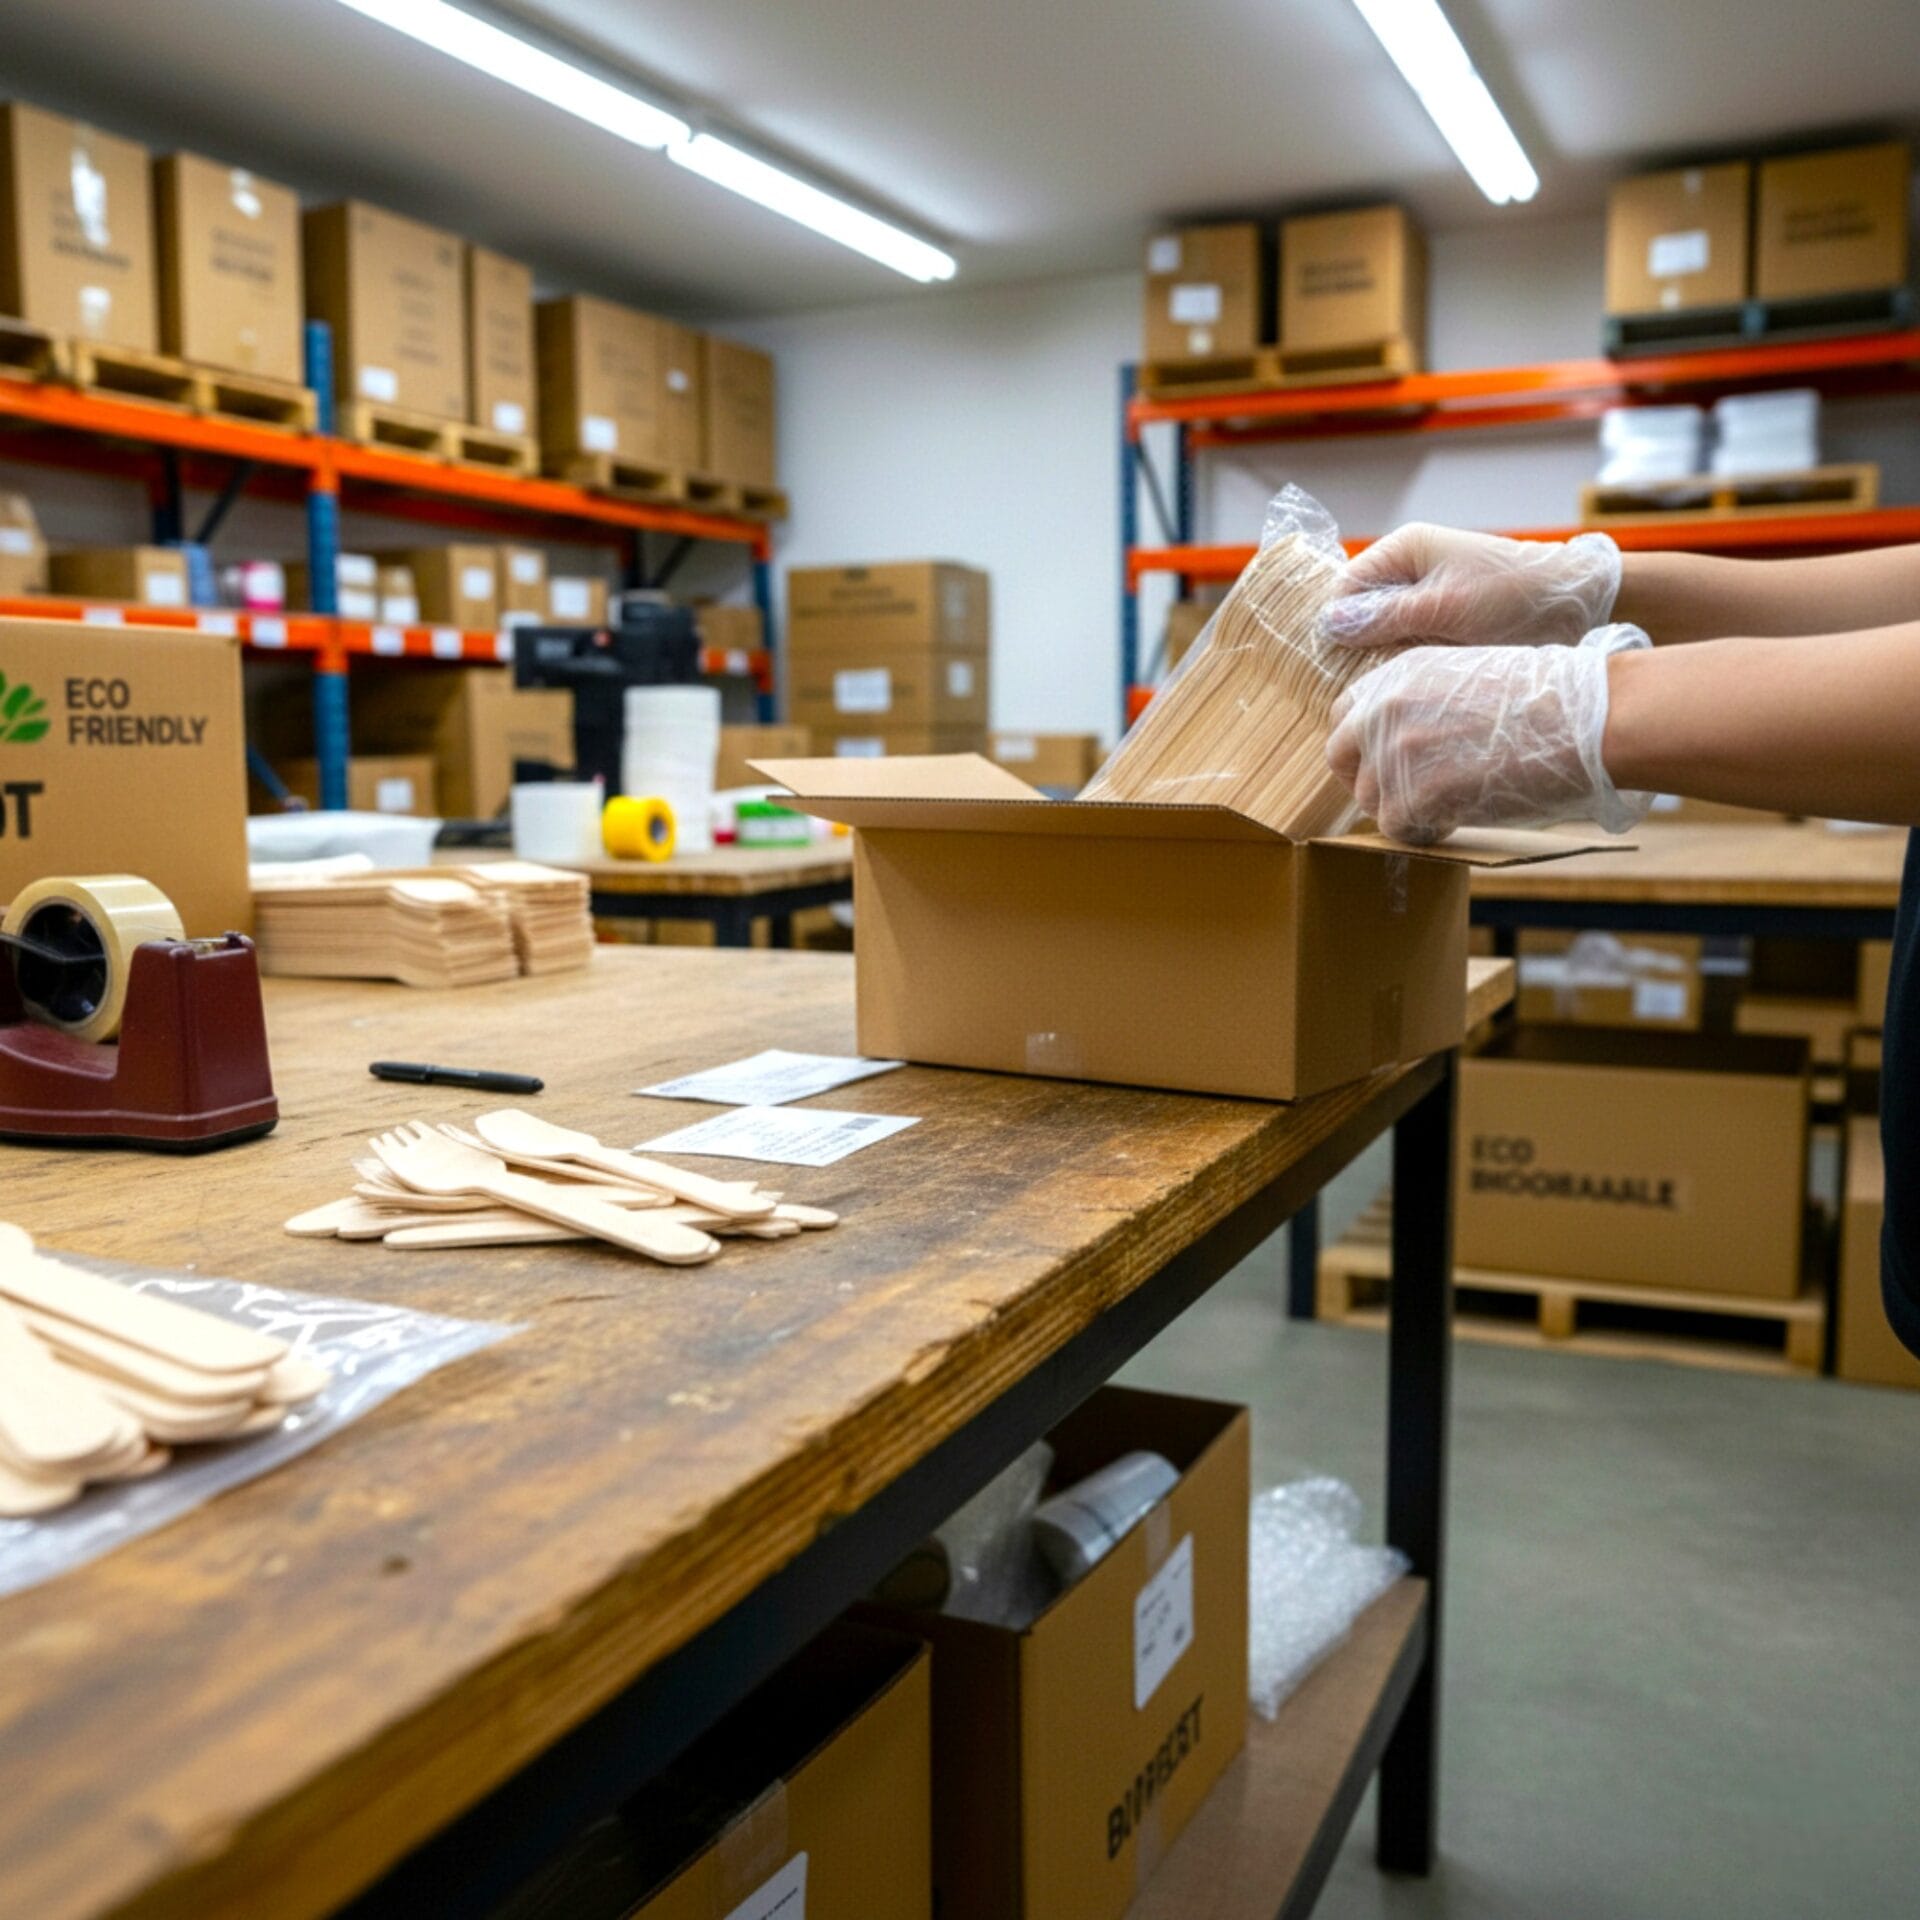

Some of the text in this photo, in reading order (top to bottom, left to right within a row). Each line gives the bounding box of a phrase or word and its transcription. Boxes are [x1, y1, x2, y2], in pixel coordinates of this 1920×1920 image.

[66, 678, 130, 710] ECO
[68, 715, 208, 745] FRIENDLY
[0, 781, 44, 838] T
